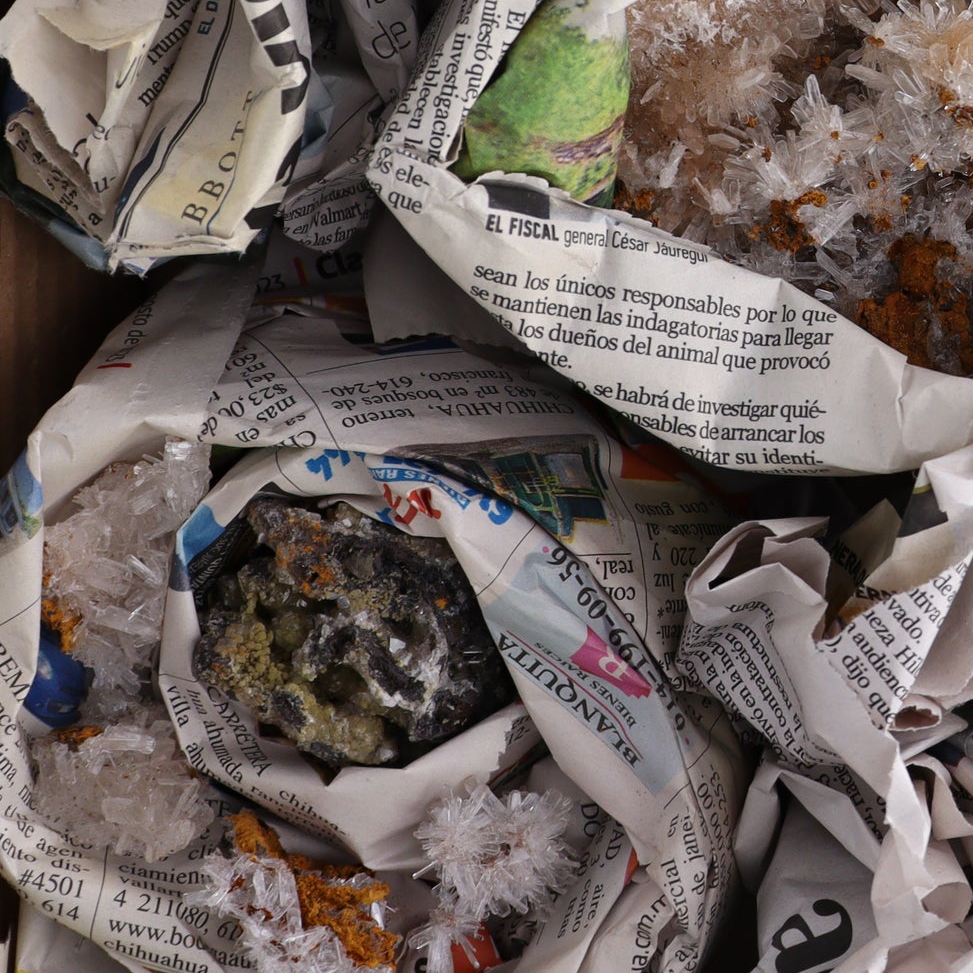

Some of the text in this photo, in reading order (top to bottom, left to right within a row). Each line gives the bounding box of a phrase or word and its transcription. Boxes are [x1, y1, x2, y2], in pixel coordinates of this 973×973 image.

[196, 17, 216, 36] EL
[484, 213, 503, 234] EL
[508, 217, 560, 242] FISCAL
[564, 228, 610, 251] general
[611, 230, 650, 252] César
[473, 265, 841, 327] sean los únicos responsables por lo que
[468, 285, 834, 350] se mantienen las indagatorias para llegar
[515, 318, 831, 375] los dueños del animal que provocó
[591, 382, 827, 422] se habrá de investigar quié-
[699, 420, 825, 445] de arrancar los
[735, 447, 826, 465] su identi-
[841, 655, 870, 689] dijo
[166, 685, 191, 727] villa
[497, 632, 642, 768] BLANQUITA
[589, 680, 637, 728] BIENES
[203, 684, 272, 778] CARRETERA
[202, 720, 244, 784] ahumada
[36, 838, 94, 860] agen-
[50, 858, 90, 873] dis-
[15, 869, 84, 898] #4501
[113, 889, 127, 908] 4
